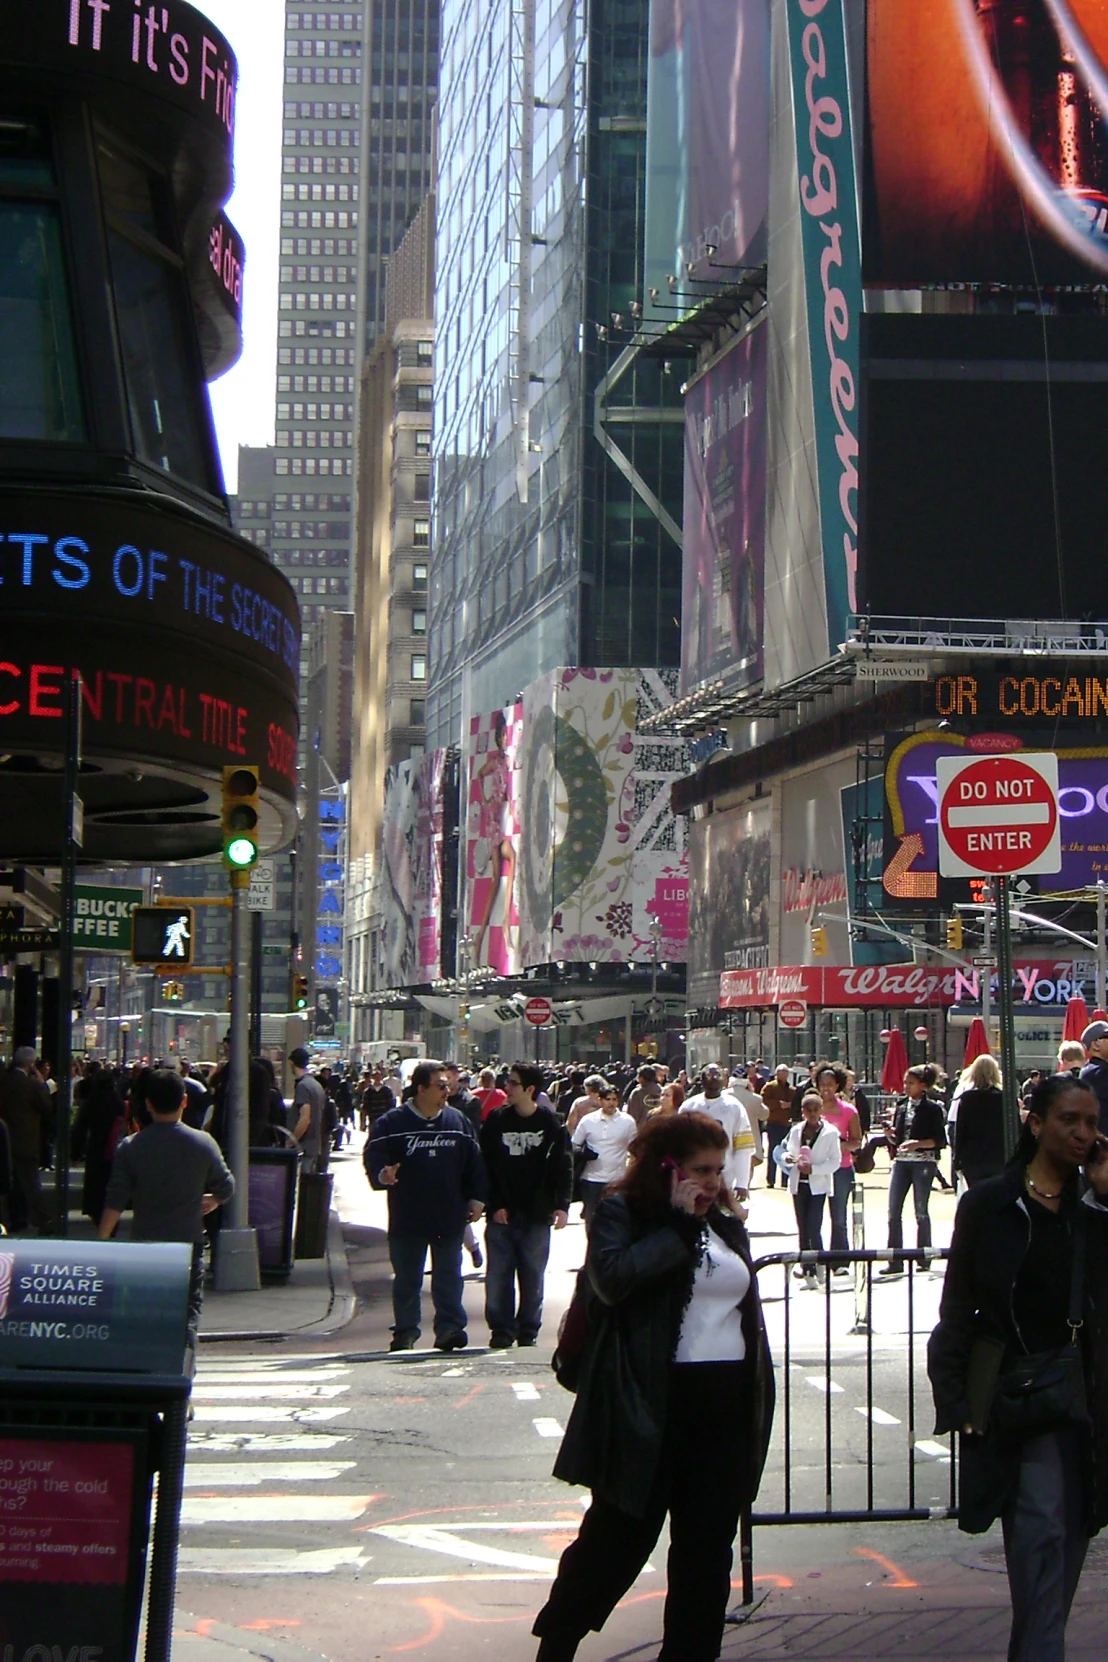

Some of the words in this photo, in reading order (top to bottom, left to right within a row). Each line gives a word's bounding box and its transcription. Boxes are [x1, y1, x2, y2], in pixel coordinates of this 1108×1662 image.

[0, 533, 91, 589] TS
[113, 544, 168, 600] OF
[179, 558, 225, 624] THE
[927, 676, 977, 715] OR
[200, 693, 248, 756] TITLE
[970, 737, 1018, 749] VACANCY
[960, 781, 987, 800] DO
[995, 779, 1034, 798] NOT
[967, 831, 1031, 852] ENTER
[1069, 843, 1084, 852] the
[250, 885, 271, 893] ALK
[756, 967, 809, 1004] Walgreens
[1015, 1031, 1050, 1041] OLICE
[405, 1135, 456, 1156] Yankees
[31, 1264, 98, 1277] TIMES
[20, 1277, 104, 1293] SQUARE
[23, 1293, 98, 1306] ALLIANCE
[19, 1460, 54, 1474] your
[43, 1479, 69, 1493] the
[75, 1480, 108, 1494] cold
[9, 1526, 36, 1539] days
[40, 1527, 52, 1537] of
[9, 1542, 32, 1552] and
[35, 1542, 79, 1555] steamy
[82, 1543, 117, 1555] offers
